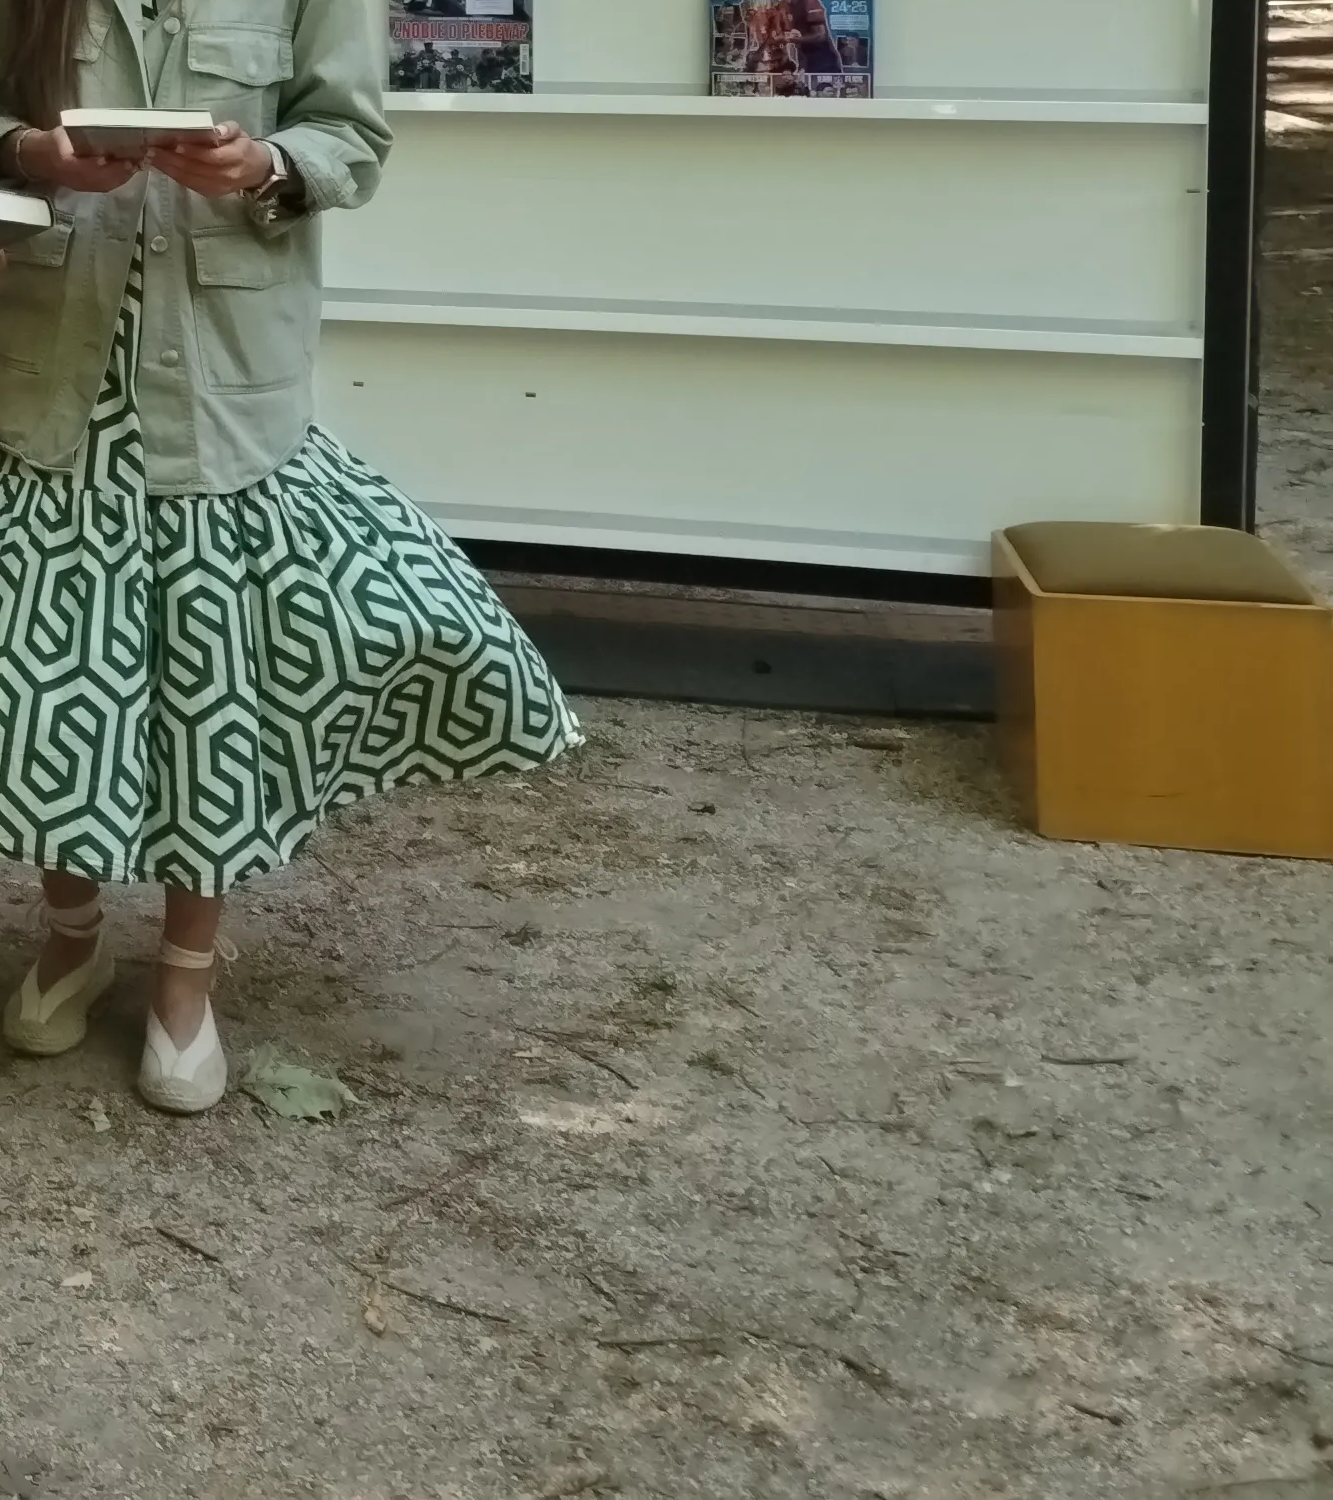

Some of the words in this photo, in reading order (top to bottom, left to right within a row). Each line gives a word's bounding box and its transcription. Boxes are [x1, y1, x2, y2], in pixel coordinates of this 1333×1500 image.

[831, 0, 868, 13] 24-25
[393, 21, 445, 40] ¿NOBLE
[460, 21, 530, 41] PLEBEYA?
